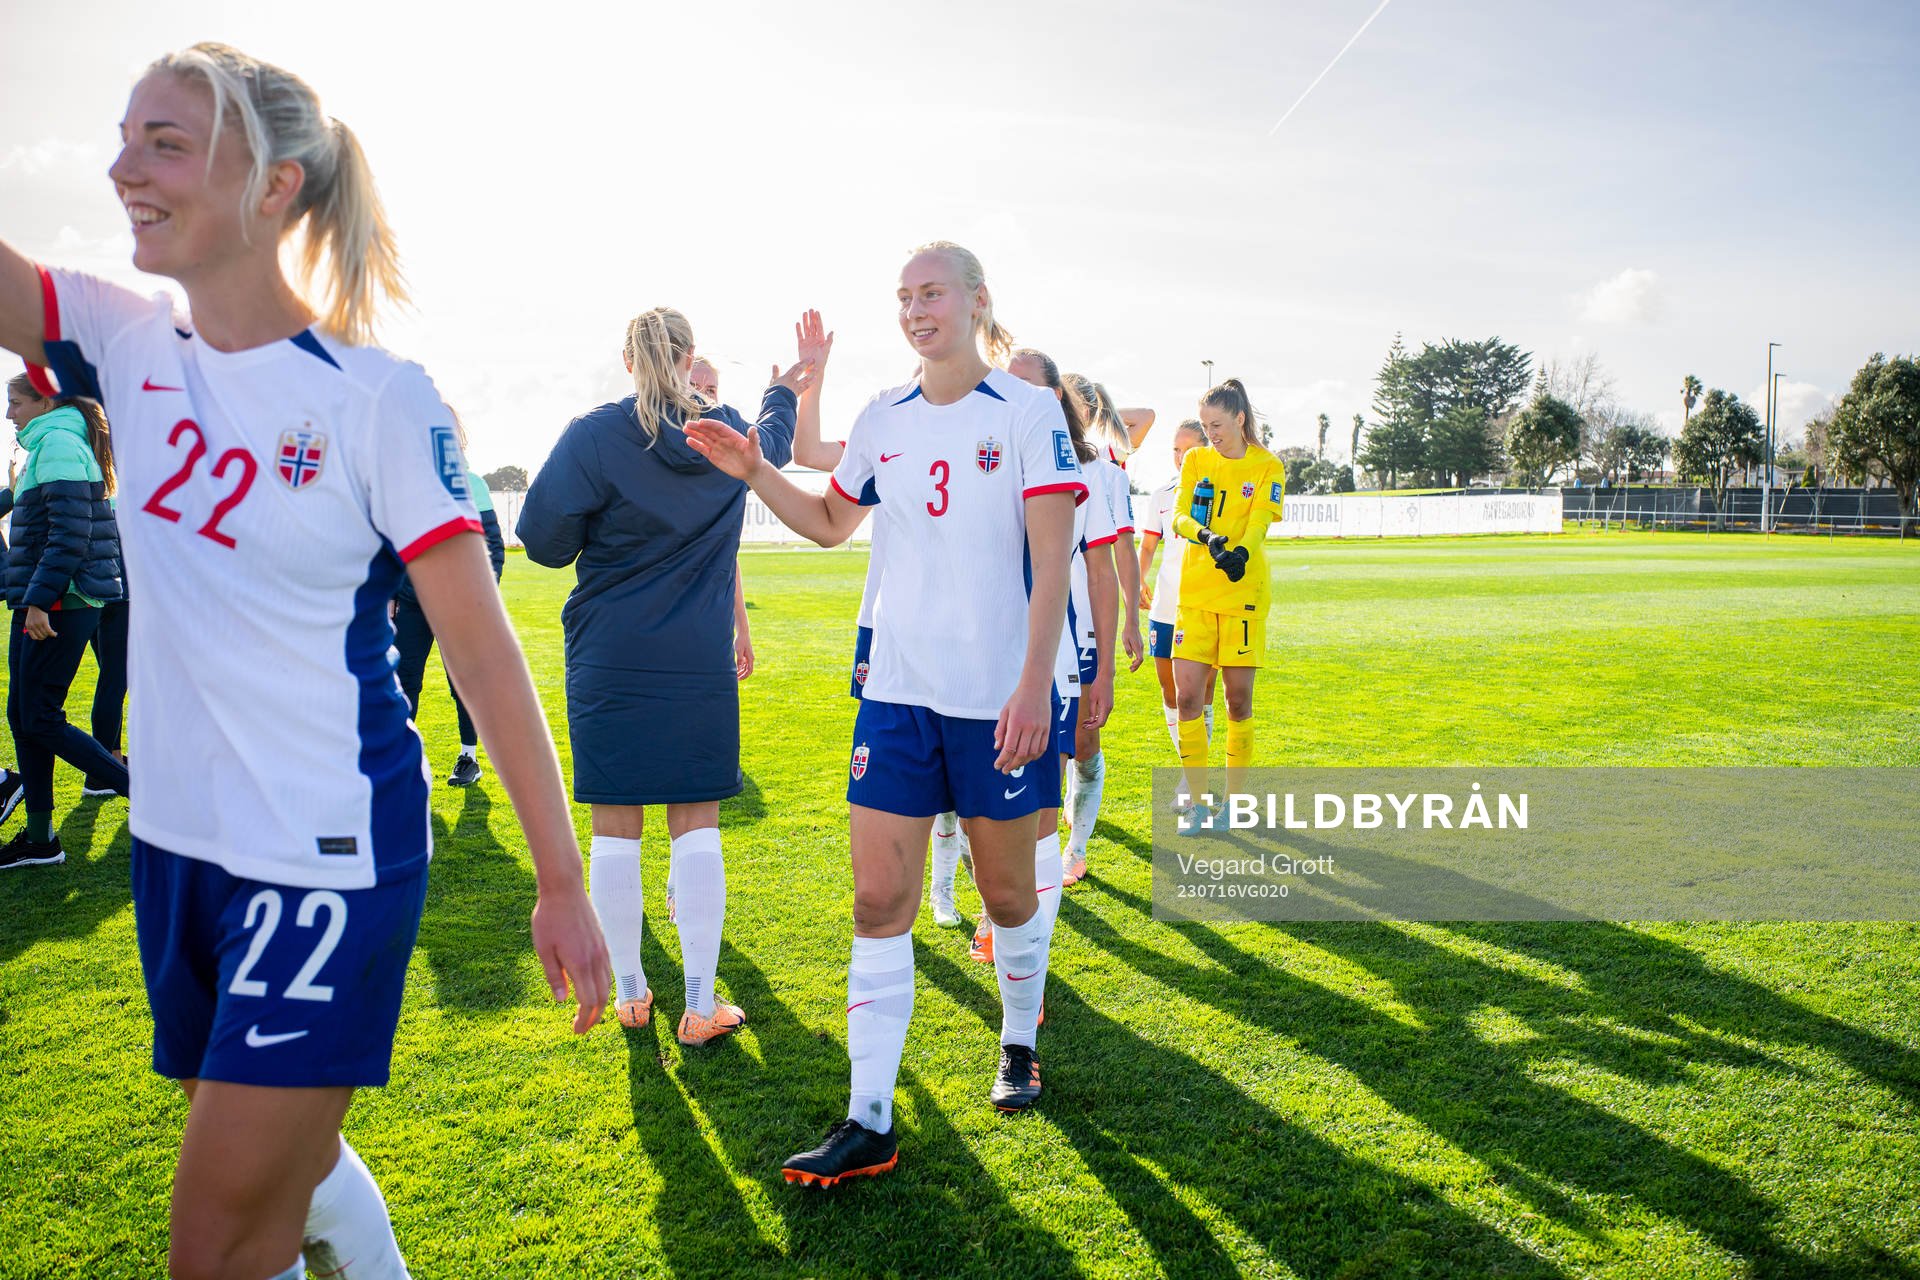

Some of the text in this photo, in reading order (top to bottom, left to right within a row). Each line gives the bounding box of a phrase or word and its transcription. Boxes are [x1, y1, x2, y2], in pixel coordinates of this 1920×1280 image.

[142, 418, 257, 549] 22
[926, 460, 949, 517] 3
[1217, 490, 1227, 517] 1
[1242, 620, 1248, 646] 1
[228, 889, 348, 1002] 22
